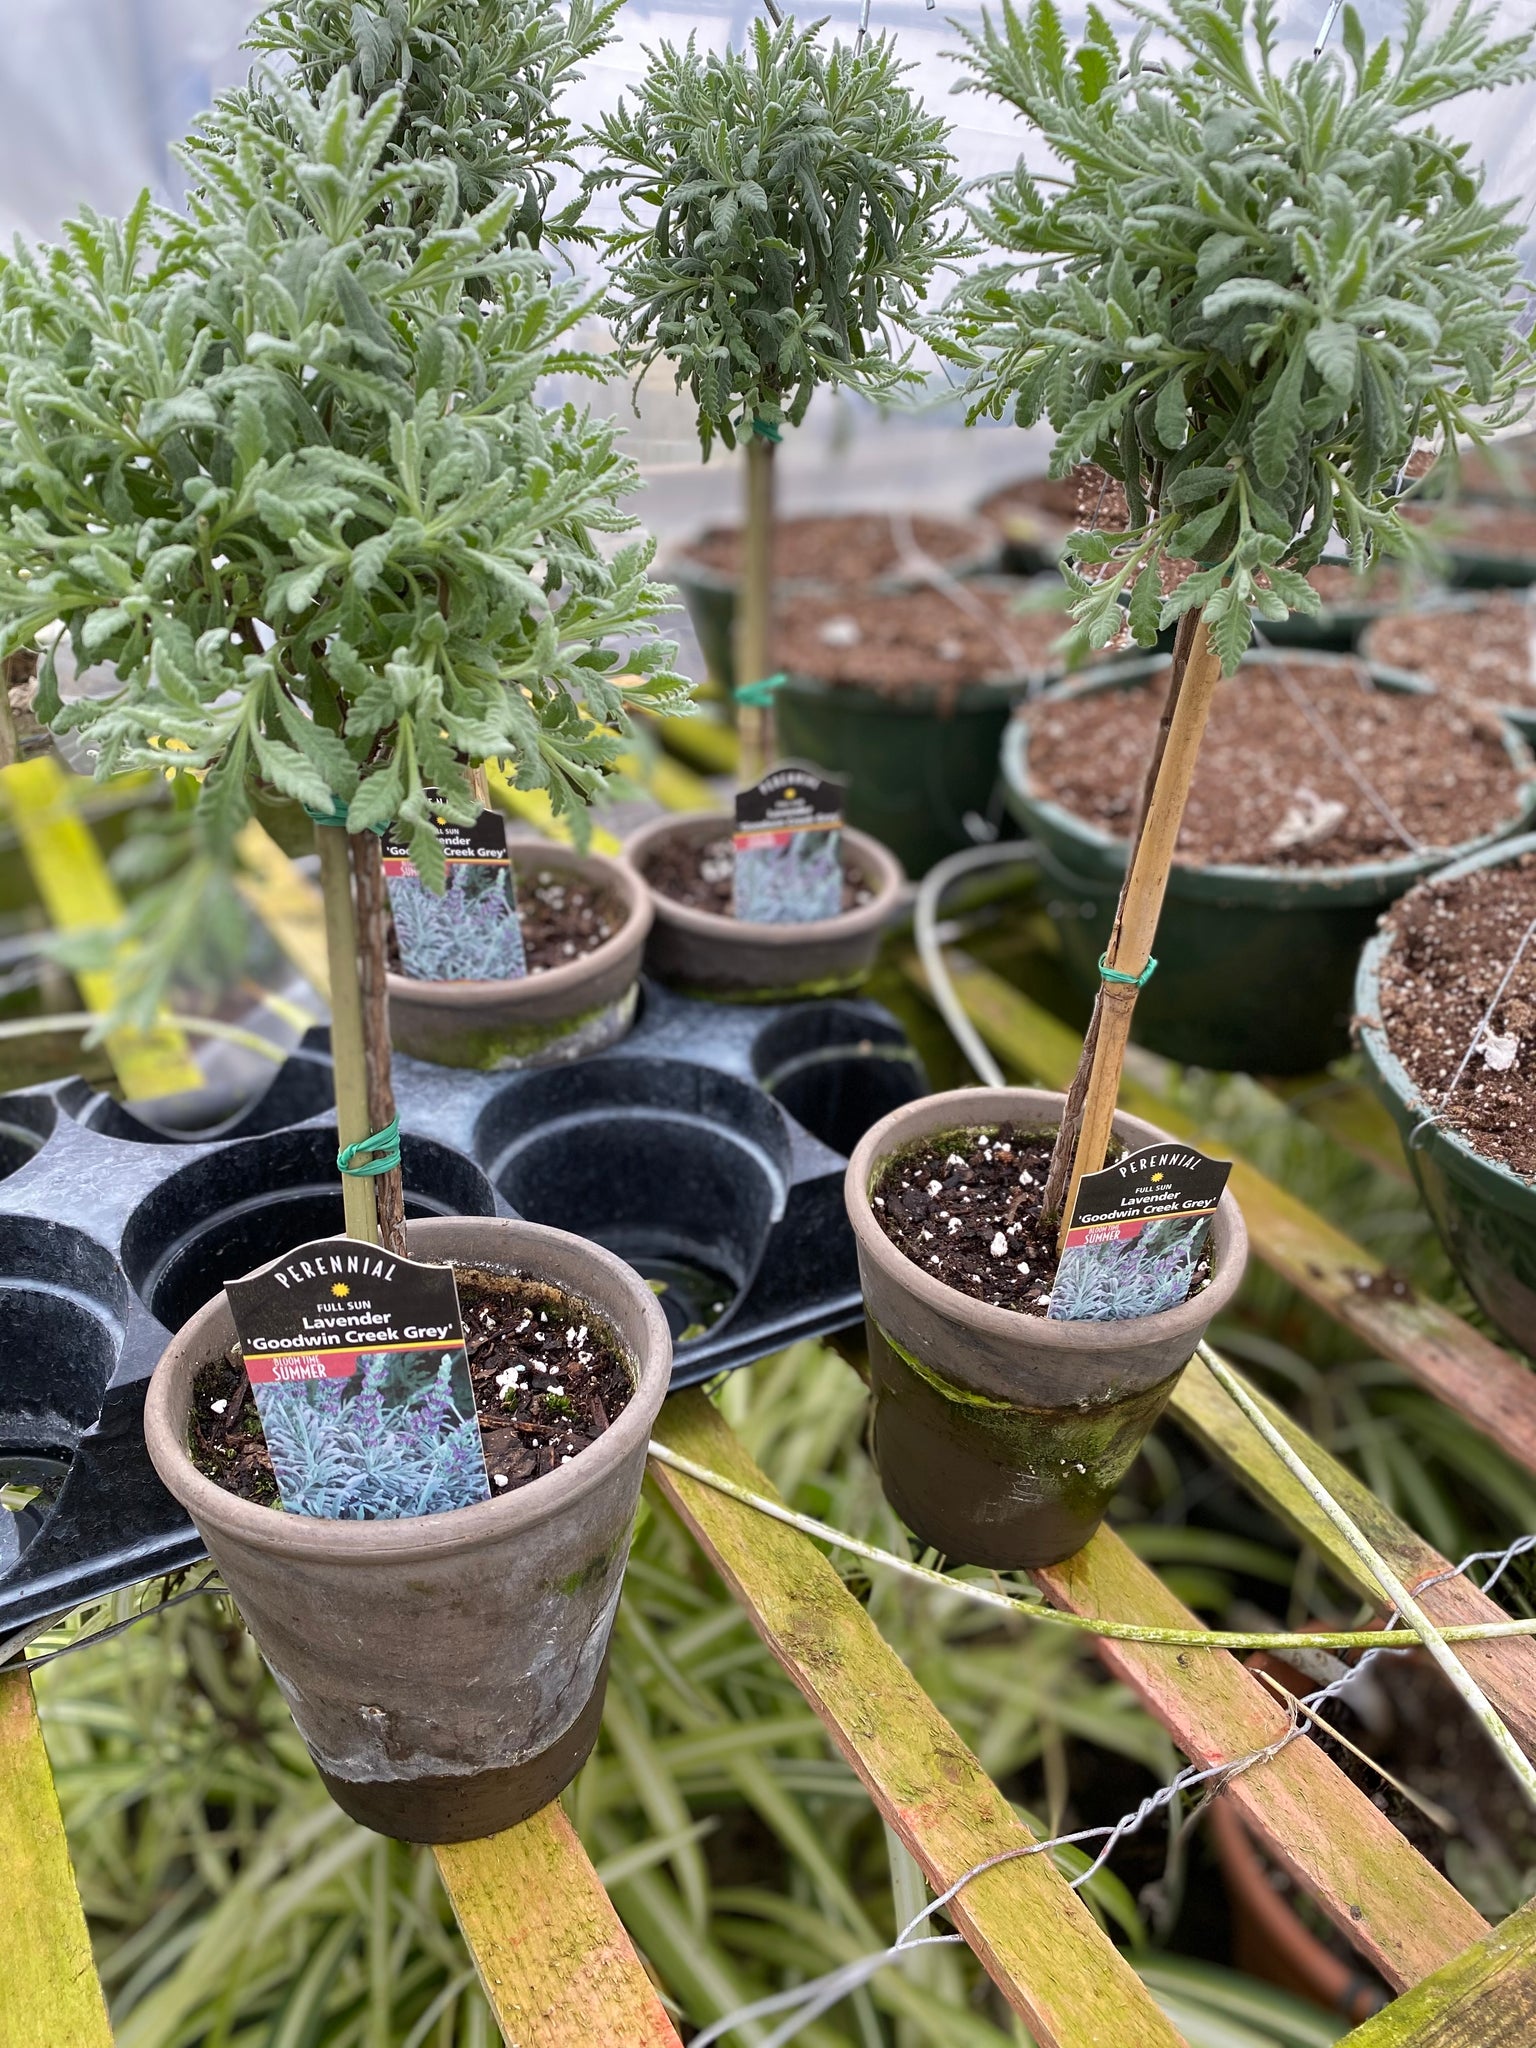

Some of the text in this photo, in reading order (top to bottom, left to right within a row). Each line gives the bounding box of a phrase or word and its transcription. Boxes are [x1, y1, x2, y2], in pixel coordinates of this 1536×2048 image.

[437, 836, 471, 845] ender
[443, 847, 475, 857] Creek
[477, 848, 506, 859] Grey'
[1119, 1153, 1202, 1179] PERENNIAL
[1135, 1183, 1172, 1194] FULL SUN
[1120, 1191, 1181, 1207] Lavender
[1078, 1197, 1217, 1224] 'Goodwin Creek Grey'
[1083, 1230, 1121, 1244] SUMMER
[274, 1255, 396, 1288] PERENNIAL
[316, 1300, 371, 1313] FULL SUN
[302, 1311, 392, 1330] Lavender
[247, 1323, 453, 1351] 'Goodwin Creek Grey'
[273, 1354, 320, 1367] BLOOM TIME
[272, 1363, 327, 1381] SUMMER
